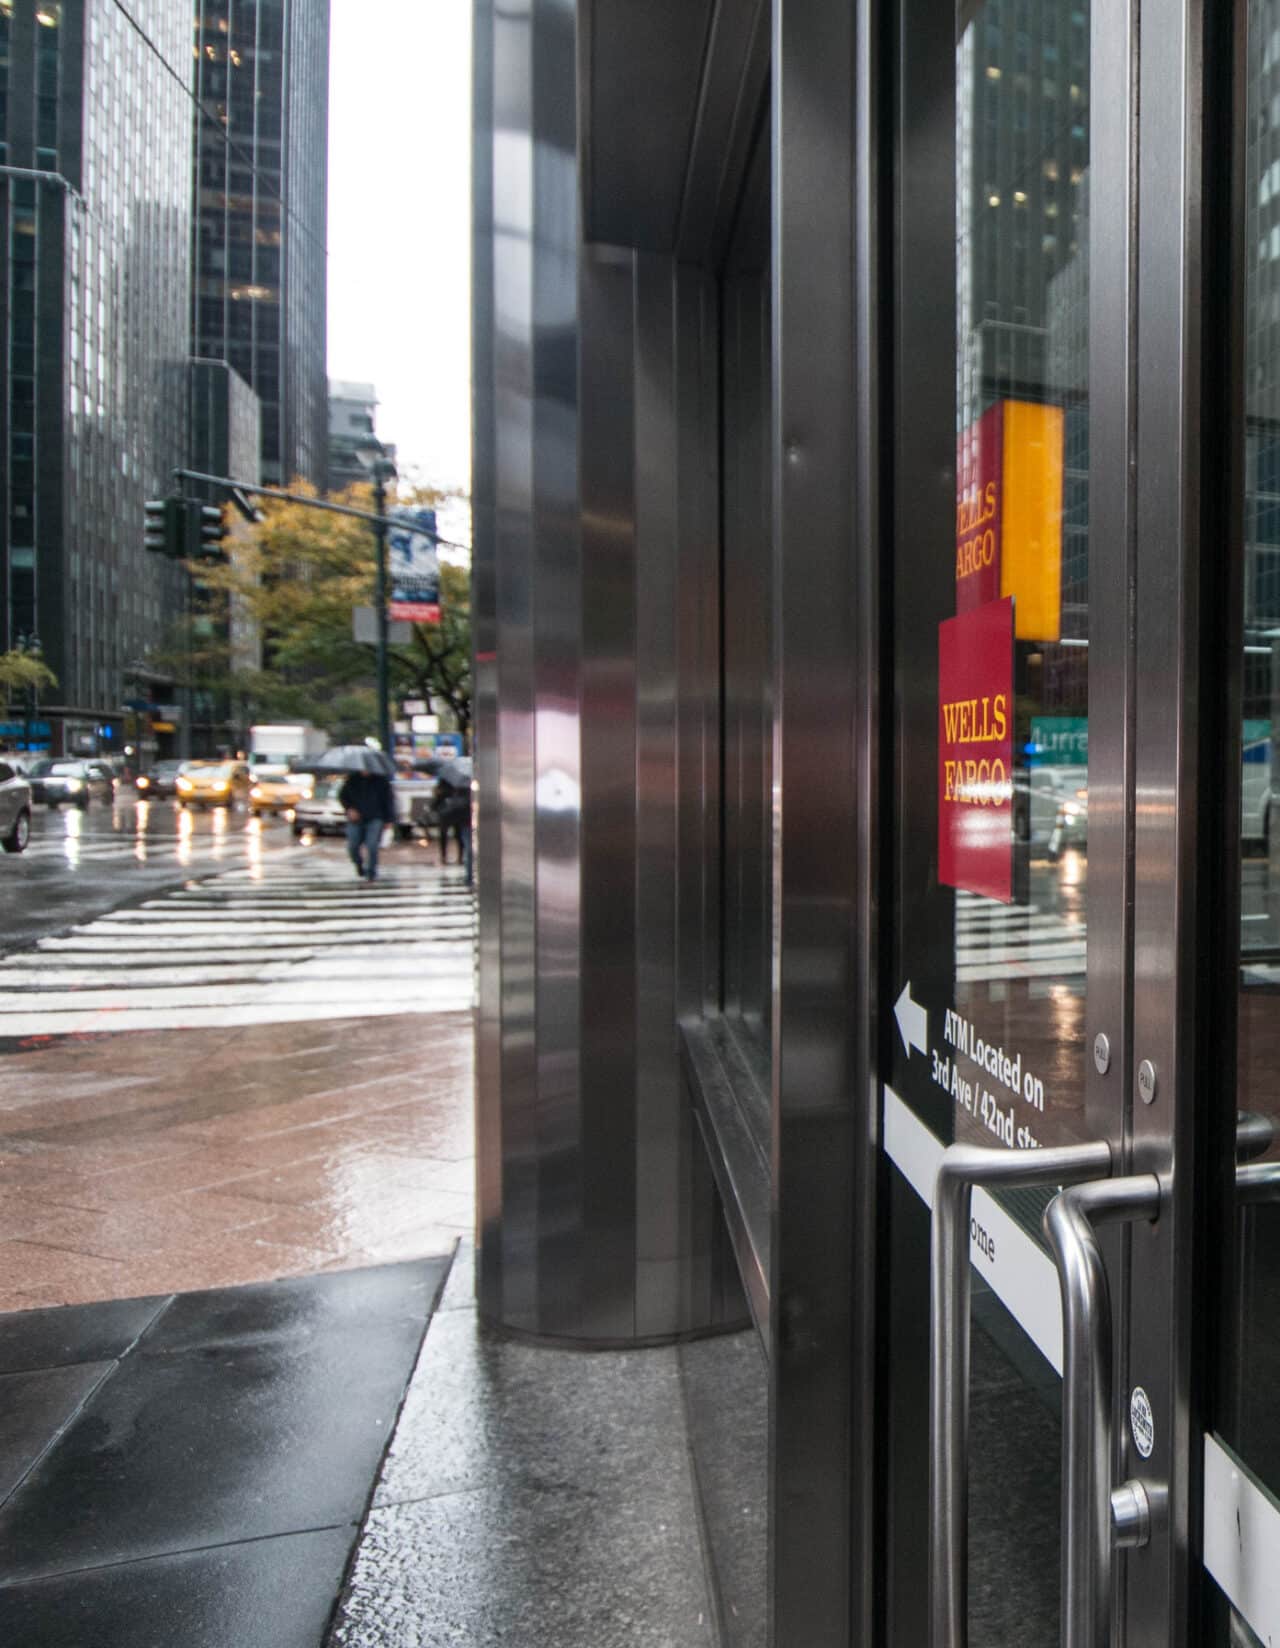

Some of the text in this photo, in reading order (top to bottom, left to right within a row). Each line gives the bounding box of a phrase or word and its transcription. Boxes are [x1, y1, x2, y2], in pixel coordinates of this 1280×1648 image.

[943, 693, 1007, 744] WELLS
[943, 758, 1007, 807] FARGO
[944, 1008, 1044, 1112] ATM Located on
[931, 1048, 949, 1092] 3rd
[951, 1064, 972, 1111] Ave
[981, 1090, 1015, 1149] 42nd
